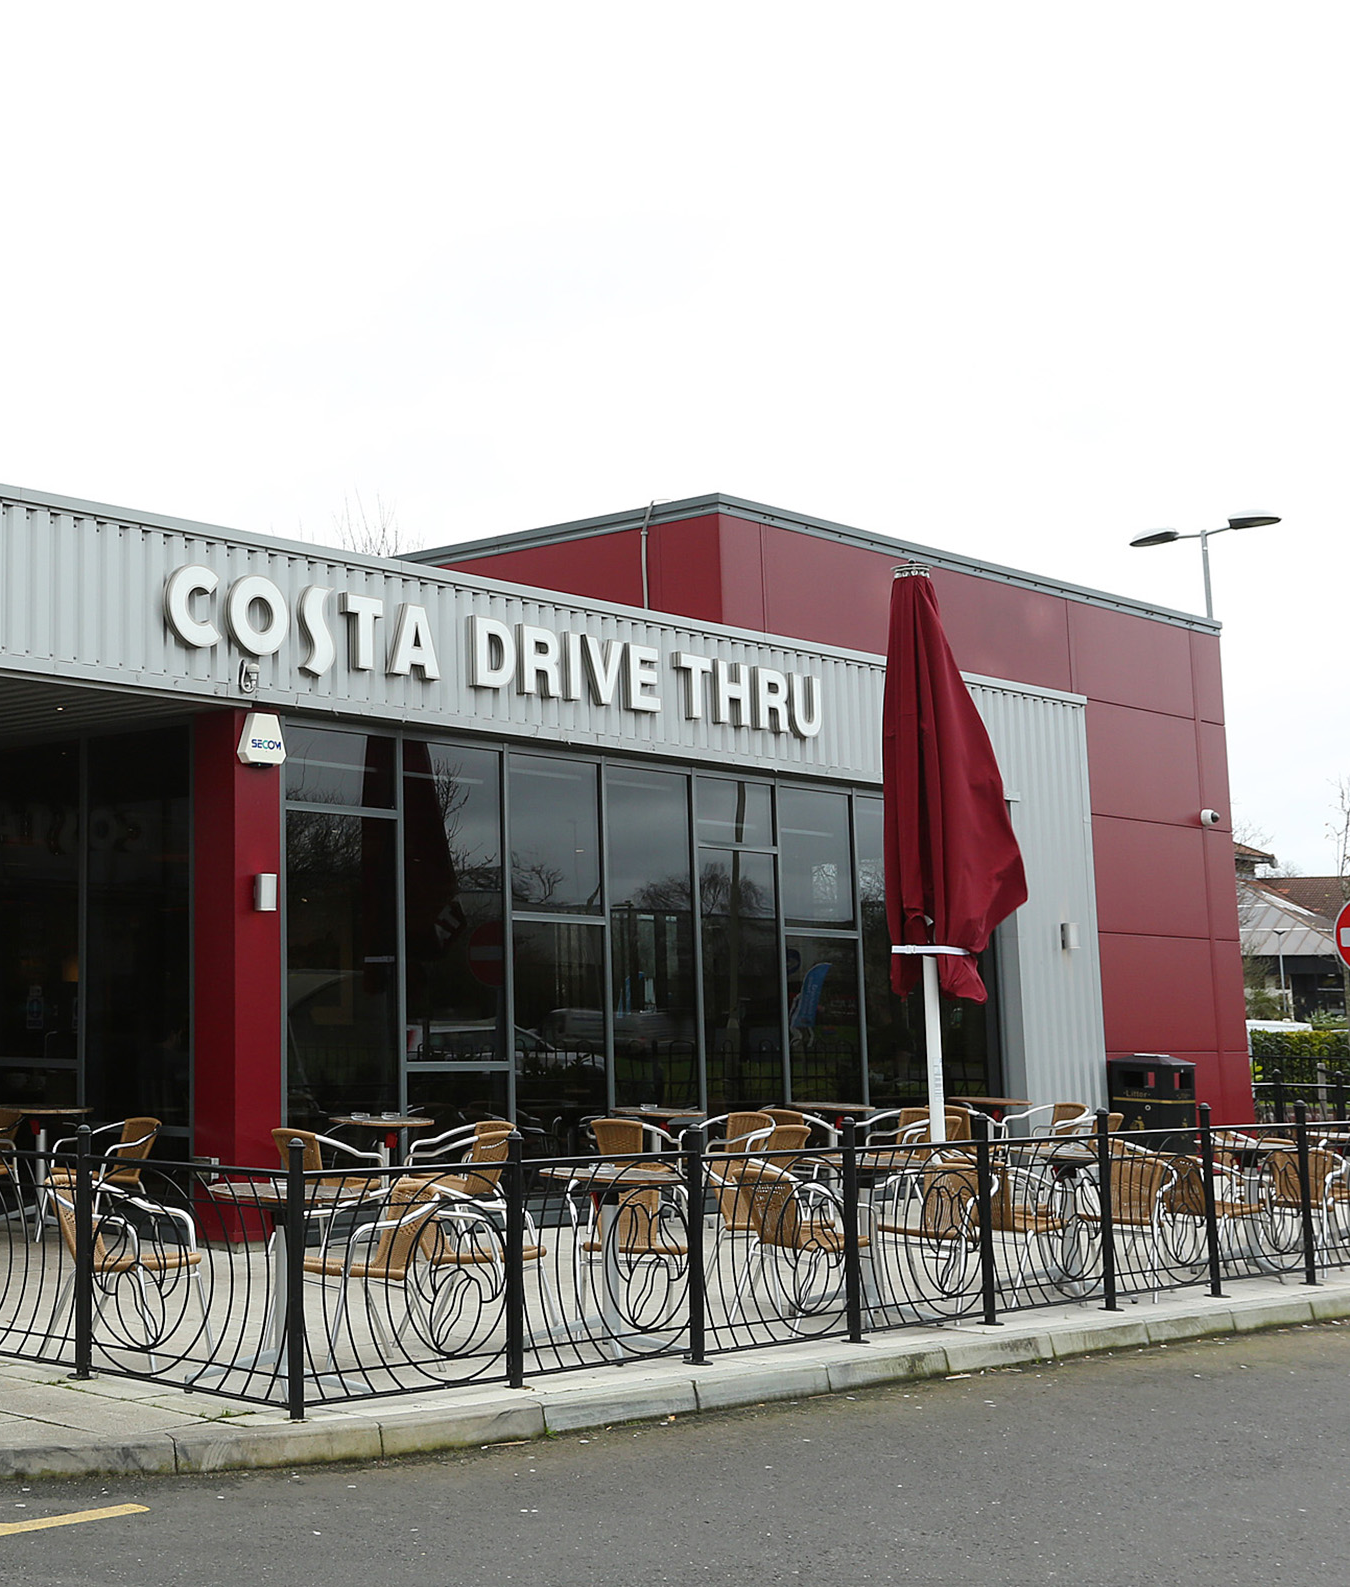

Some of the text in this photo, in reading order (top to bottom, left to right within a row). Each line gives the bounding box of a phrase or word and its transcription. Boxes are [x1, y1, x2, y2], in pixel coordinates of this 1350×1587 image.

[164, 564, 822, 739] COSTA DRIVE THRU
[251, 739, 282, 750] SECOM
